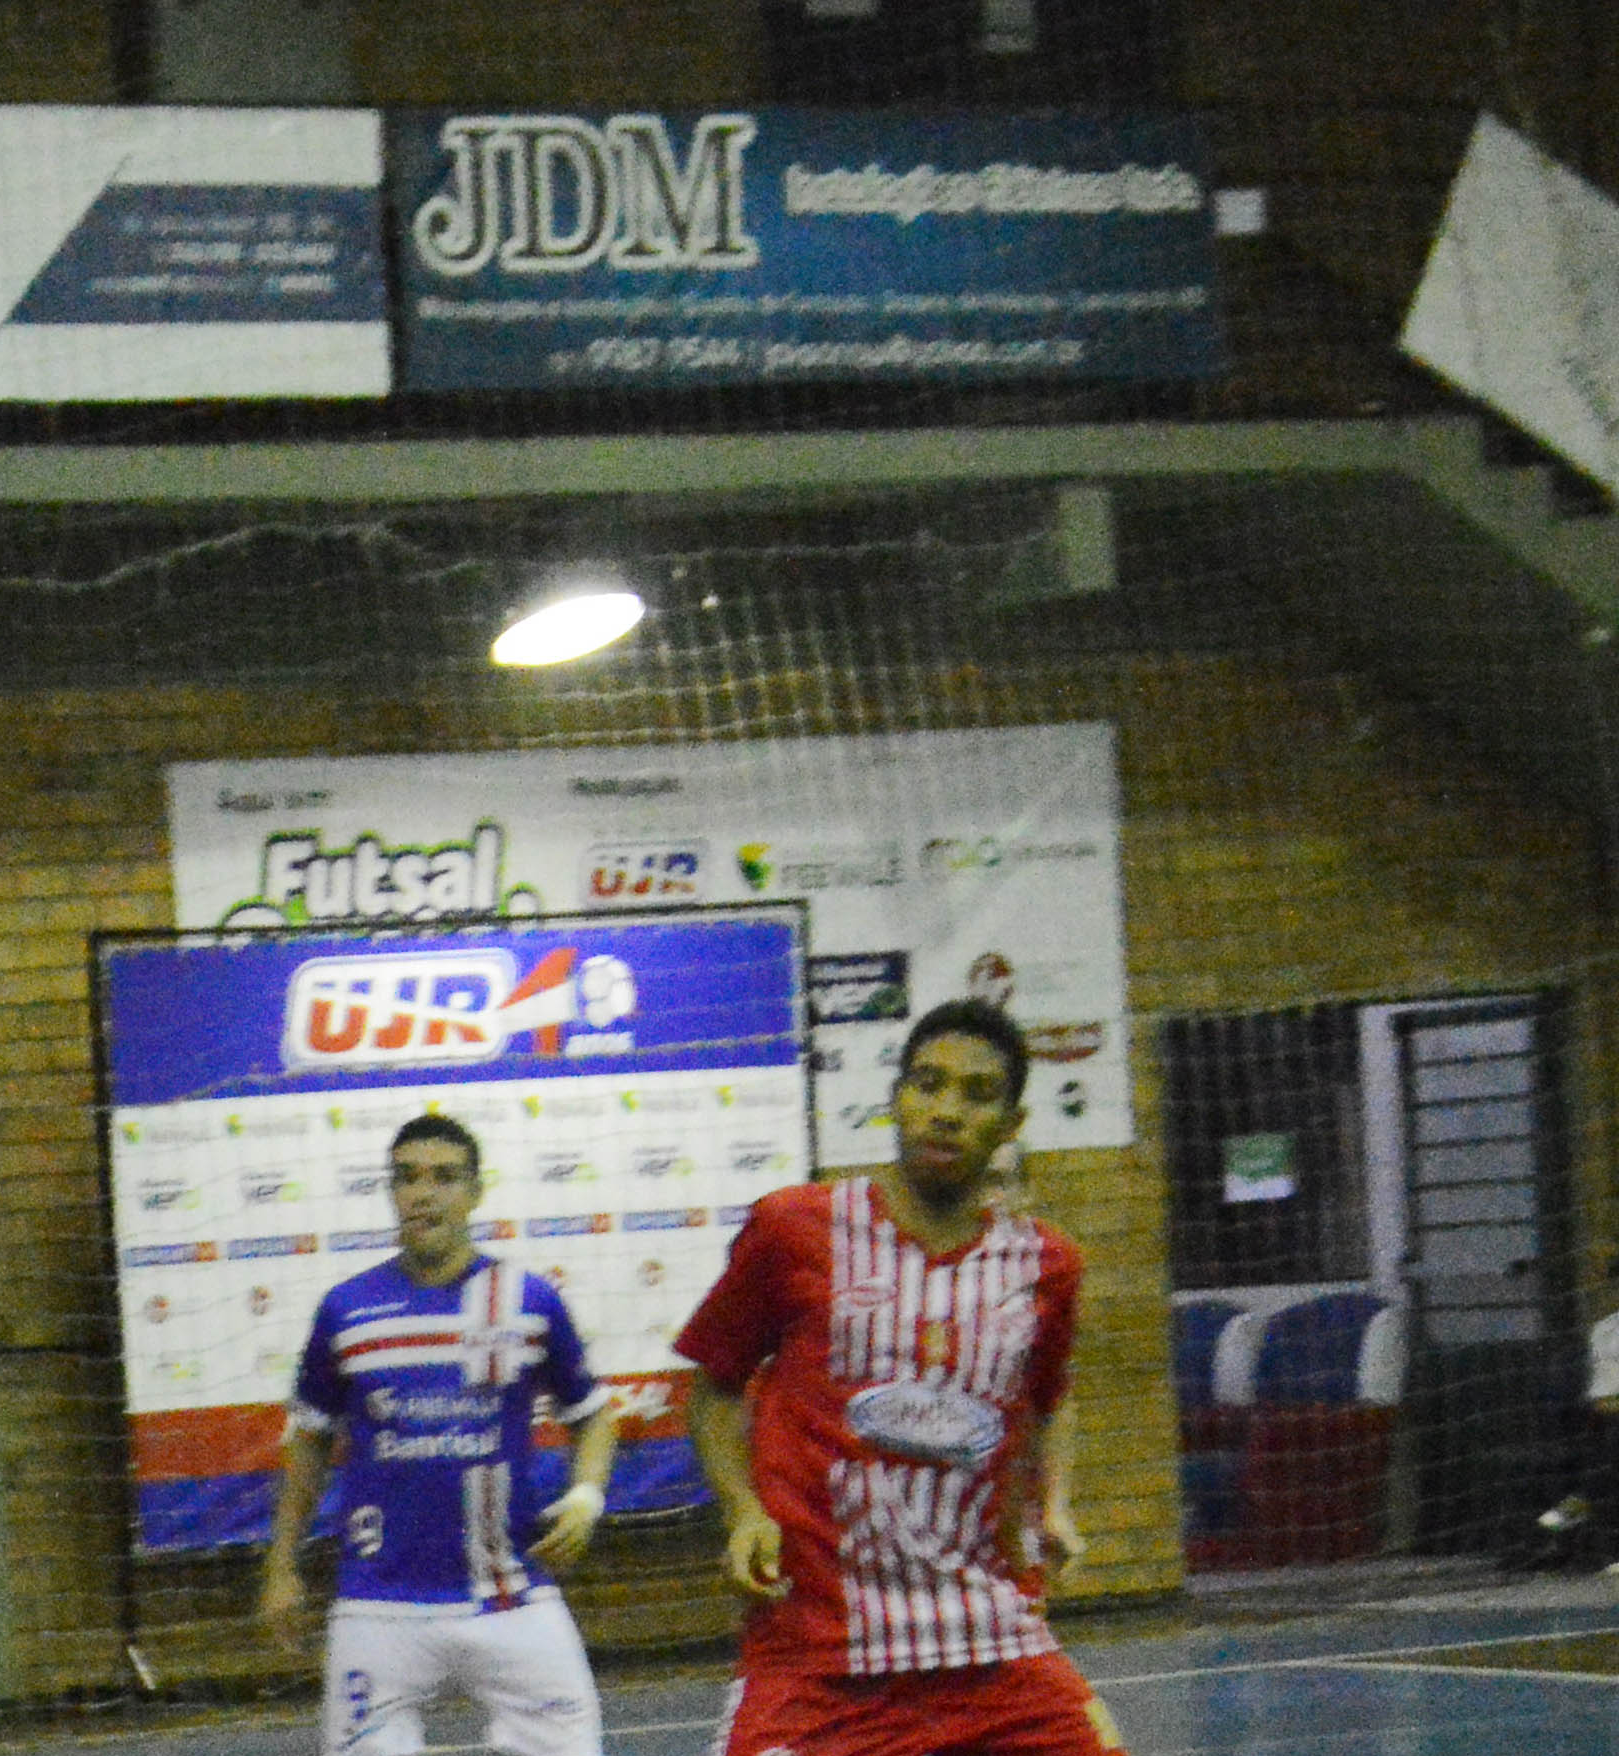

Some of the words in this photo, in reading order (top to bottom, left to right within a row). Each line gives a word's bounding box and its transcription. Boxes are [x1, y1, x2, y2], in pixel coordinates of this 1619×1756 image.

[412, 114, 758, 276] JDM
[264, 822, 503, 917] Futsal
[308, 968, 493, 1055] UJR
